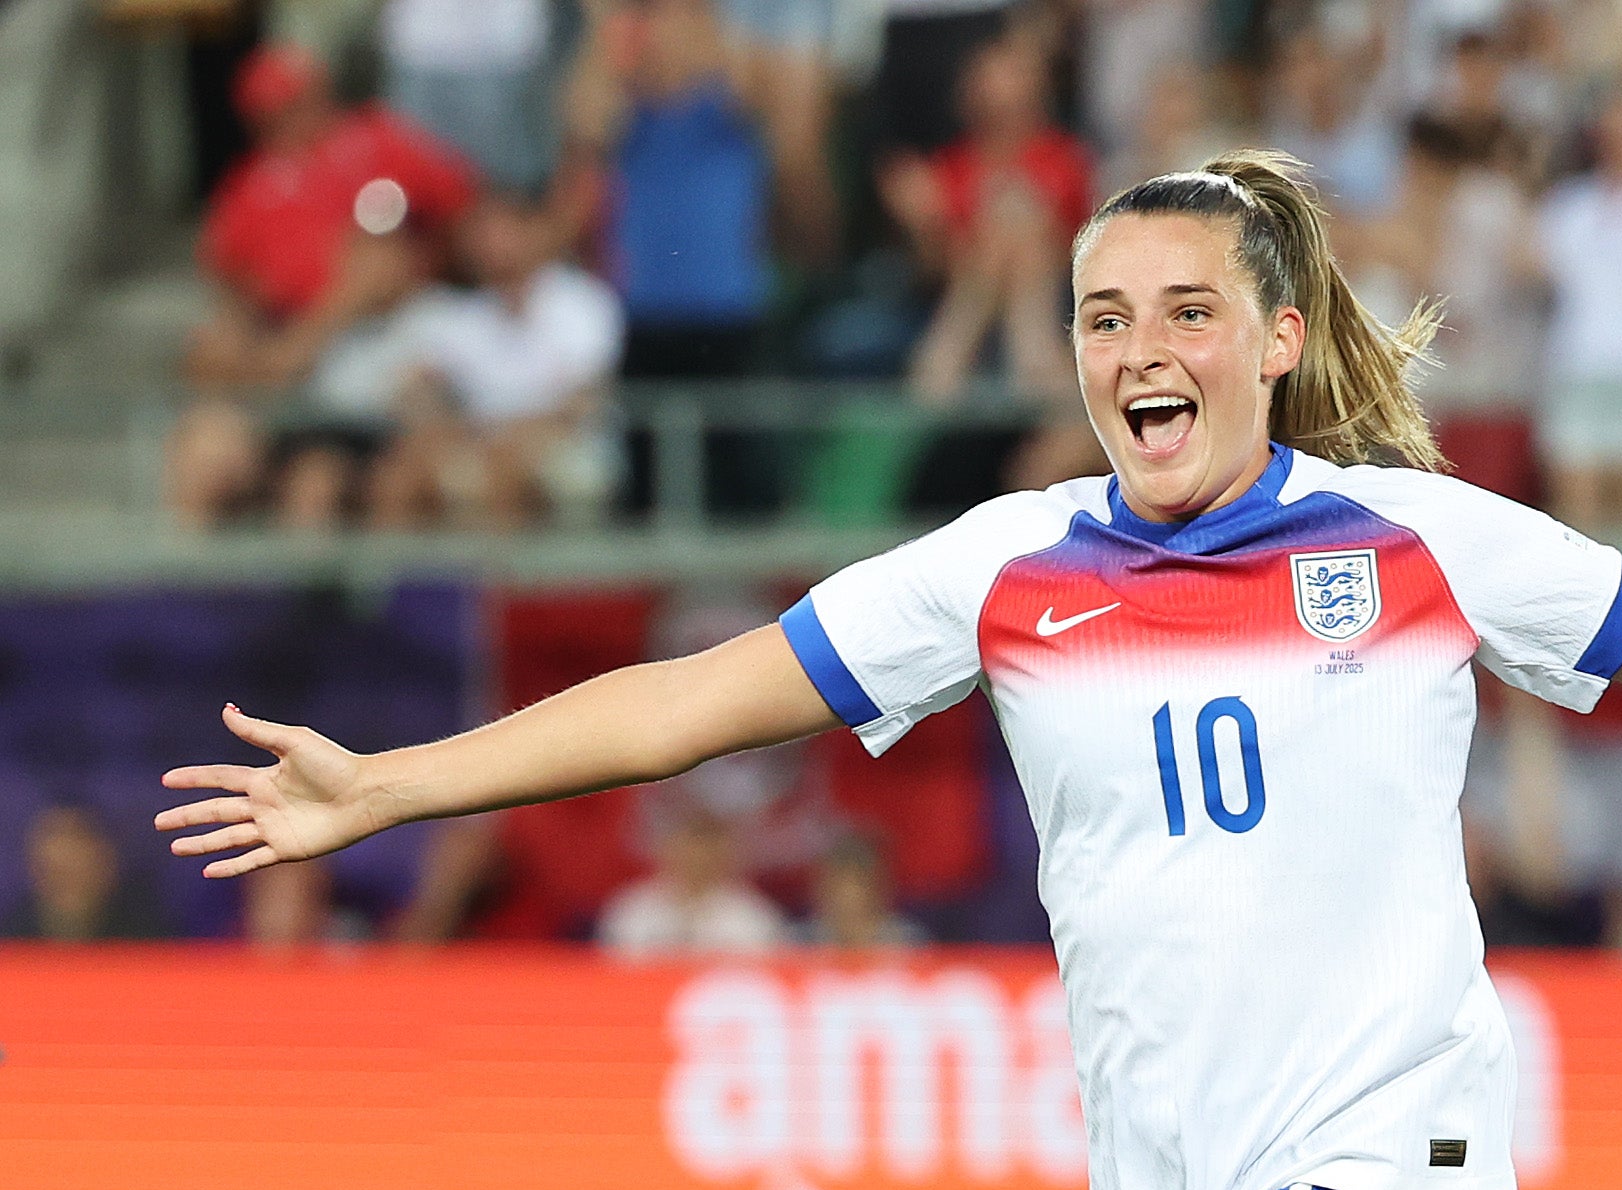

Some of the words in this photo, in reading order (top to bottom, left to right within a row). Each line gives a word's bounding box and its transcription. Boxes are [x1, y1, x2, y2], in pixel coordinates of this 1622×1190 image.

[1329, 649, 1355, 661] WALES
[1324, 663, 1344, 675] JULY
[1345, 662, 1364, 674] 2025
[1152, 695, 1266, 836] 10
